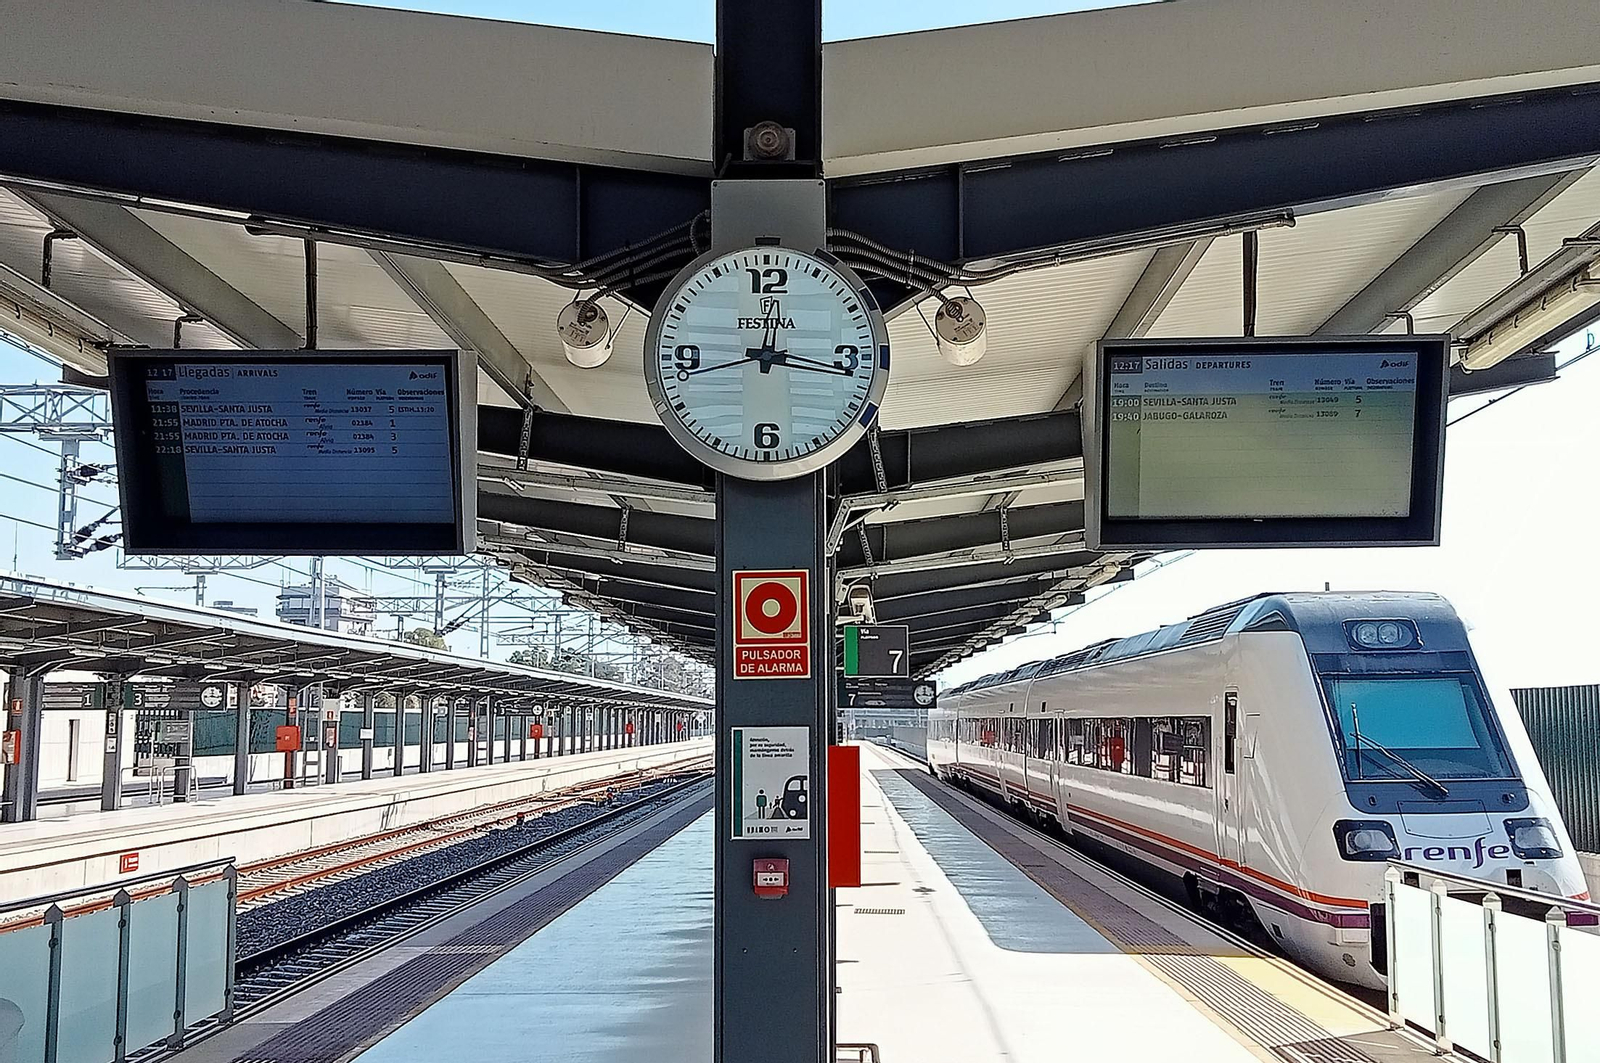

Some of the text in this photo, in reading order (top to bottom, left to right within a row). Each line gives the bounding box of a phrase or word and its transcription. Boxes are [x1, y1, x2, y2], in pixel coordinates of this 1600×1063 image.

[745, 268, 788, 294] 12
[737, 317, 796, 330] FESTINA
[674, 345, 701, 370] 9
[833, 345, 860, 371] 3
[1113, 358, 1251, 370] 12:17 Salidas DEPARTURES
[179, 366, 230, 380] Llegadas
[237, 369, 279, 377] ARRIVALS
[180, 388, 220, 396] Procedencia
[397, 388, 445, 396] Observaciones
[1112, 397, 1237, 407] 19:00 SEVILLA-SANTA JUSTA
[1355, 395, 1362, 404] 5
[151, 405, 273, 413] 11:38 SEVILLA-SANTA JUSTA
[388, 405, 395, 413] 5
[1355, 409, 1361, 418] 7
[1112, 411, 1228, 421] 19:40 JABUGO-GALAROZA
[153, 419, 288, 427] 21:55 MADRID PTA. DE ATOCHA
[390, 419, 395, 427] 1
[154, 432, 289, 440] 21:55 MADRID PTA. DE ATOCHA
[306, 430, 327, 438] renfe
[391, 433, 397, 441] 3
[753, 423, 780, 449] 6
[156, 446, 276, 454] 22:18 SEVILLA-SANTA JUSTA
[392, 446, 398, 454] 5
[742, 649, 801, 660] PULSADOR
[889, 650, 903, 673] 7
[740, 663, 803, 673] DE ALARMA
[84, 694, 92, 706] 1
[134, 693, 142, 706] 3
[848, 694, 856, 706] 7
[1404, 837, 1509, 869] renfe
